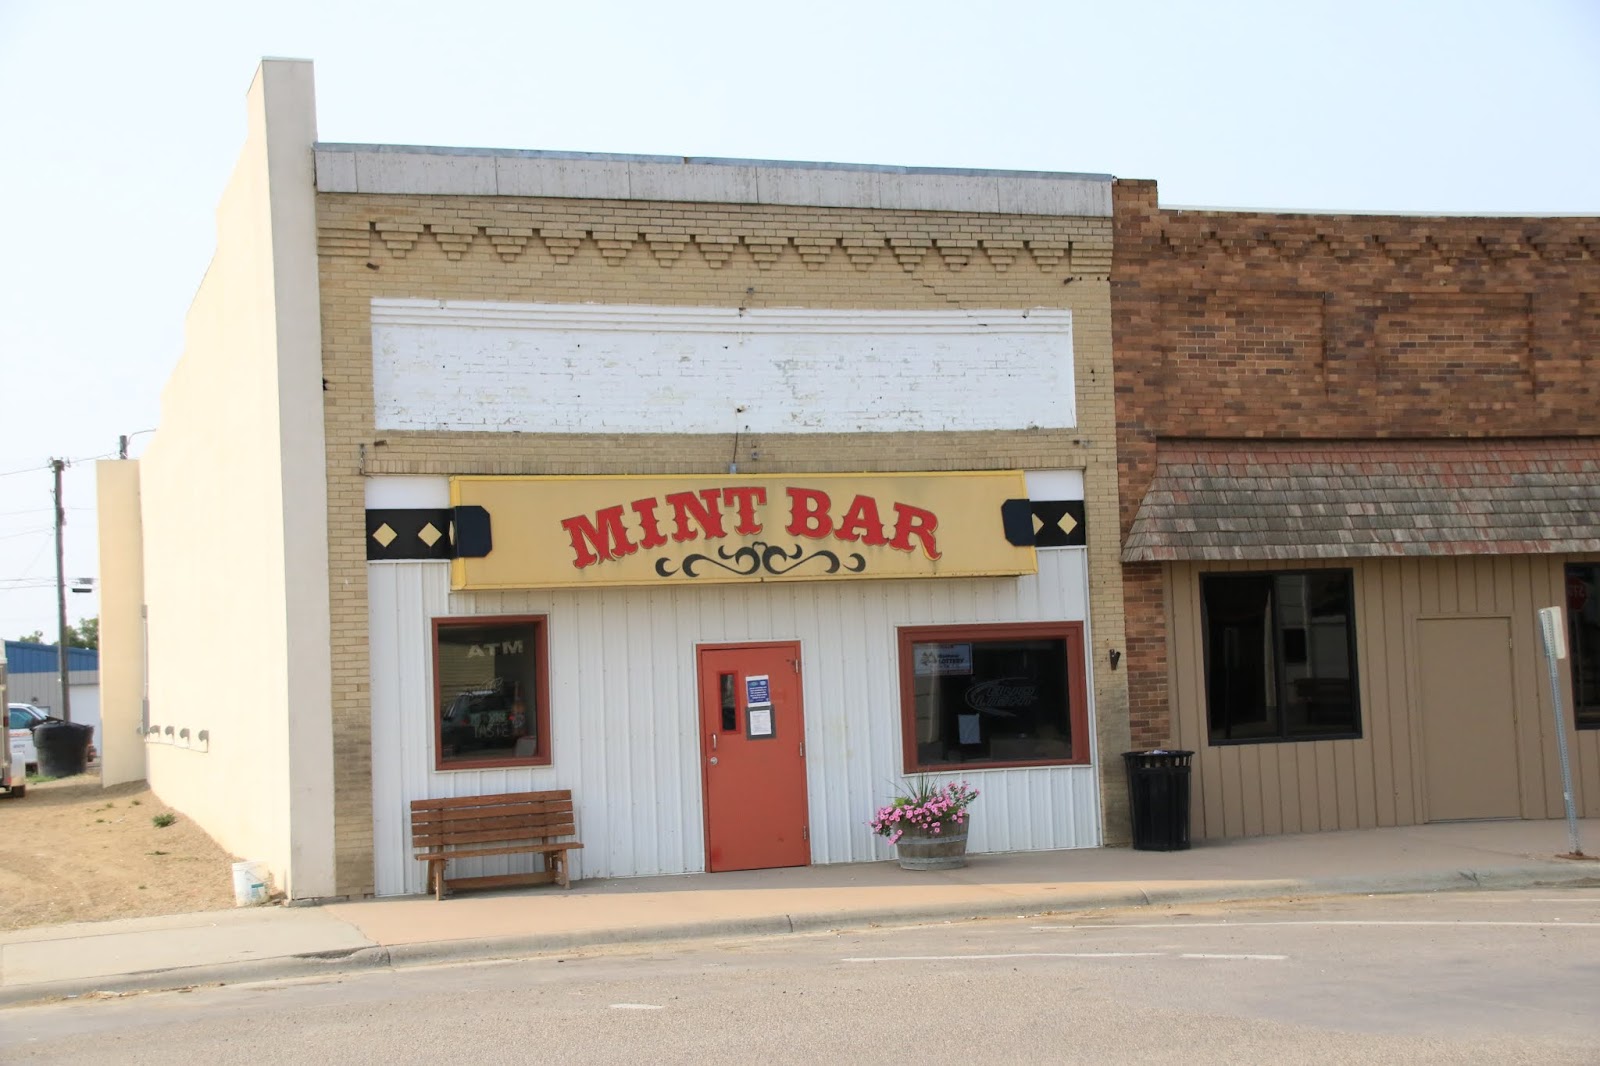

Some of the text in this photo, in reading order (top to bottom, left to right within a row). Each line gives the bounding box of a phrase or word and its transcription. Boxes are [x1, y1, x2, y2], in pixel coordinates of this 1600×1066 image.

[561, 486, 943, 568] MINT BAR
[468, 640, 523, 658] ATM
